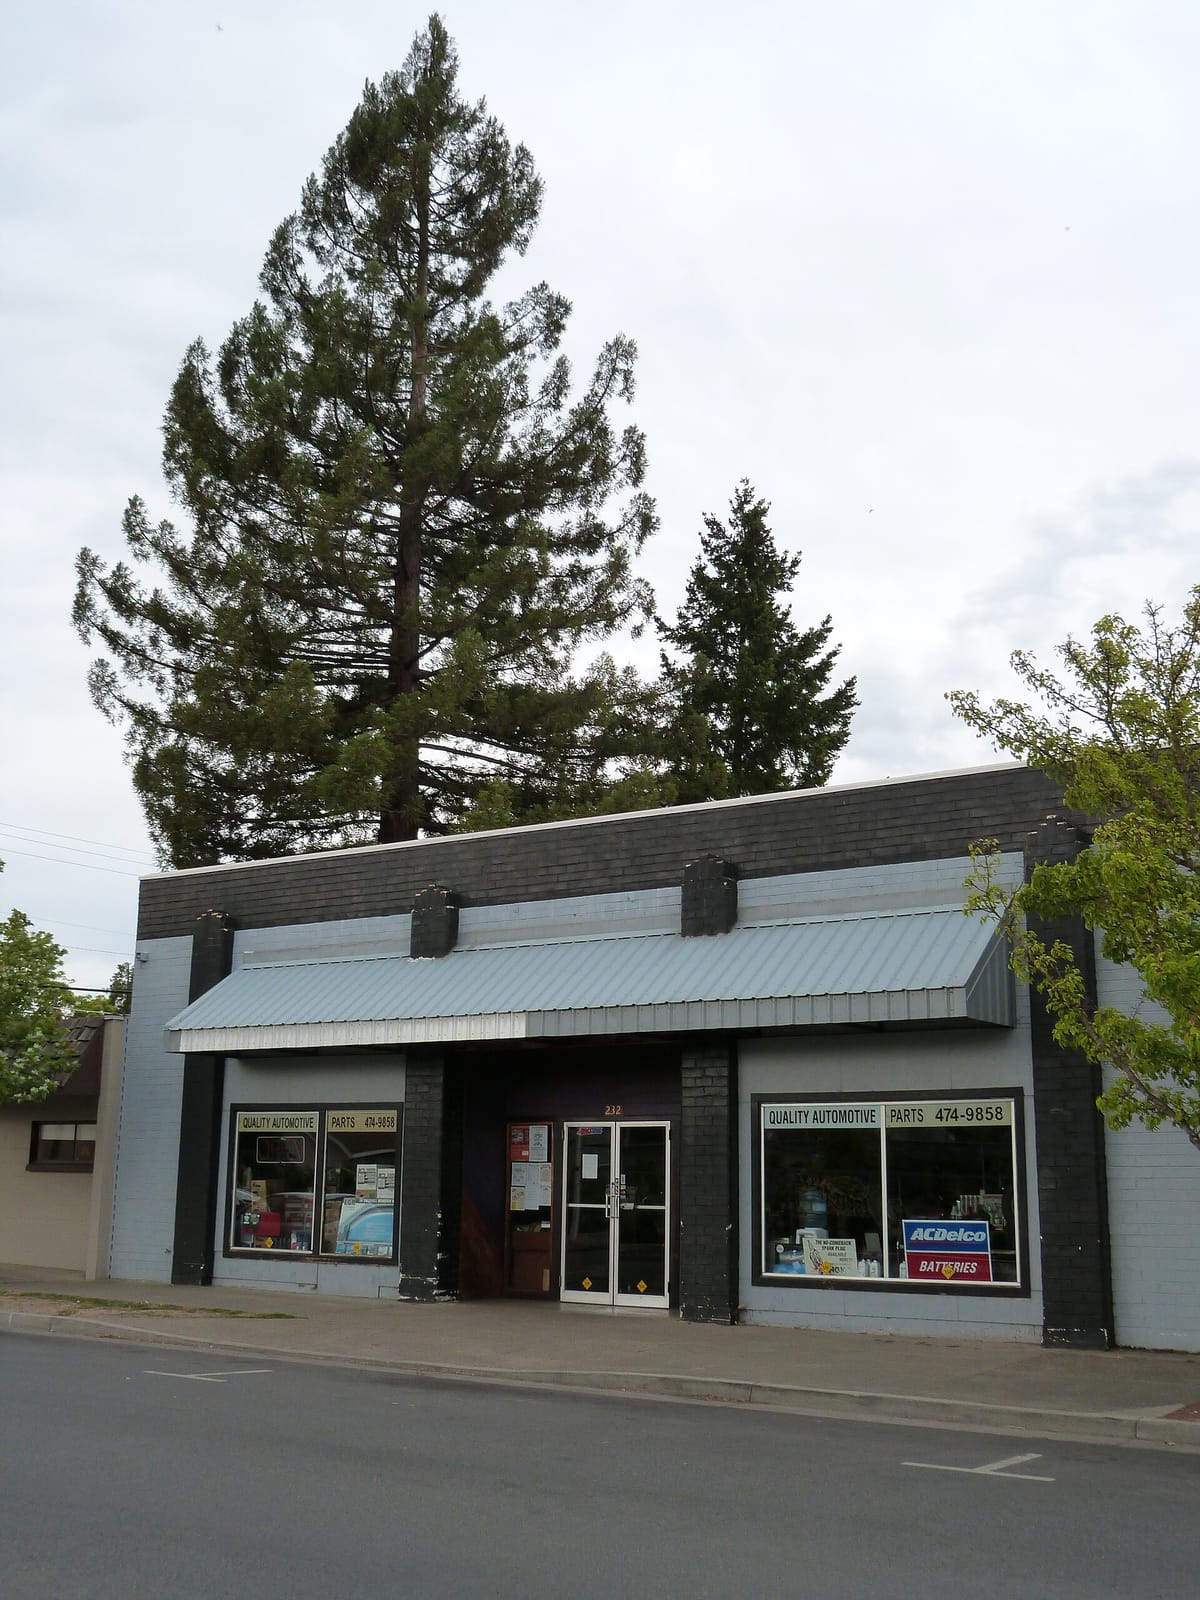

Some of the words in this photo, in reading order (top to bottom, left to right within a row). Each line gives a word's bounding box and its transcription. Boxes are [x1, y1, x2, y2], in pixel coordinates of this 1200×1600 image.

[604, 1105, 622, 1115] 232
[890, 1108, 924, 1123] PARTS
[935, 1106, 1003, 1122] 474-9858
[242, 1117, 270, 1129] QUALITY
[272, 1117, 315, 1129] AUTOMOTIVE
[331, 1116, 355, 1129] PARTS
[364, 1116, 395, 1129] 474-9858
[769, 1110, 809, 1125] QUALITY
[812, 1109, 876, 1124] AUTOMOTIVE
[910, 1227, 987, 1242] ACDelco
[919, 1261, 978, 1274] BATTERIES
